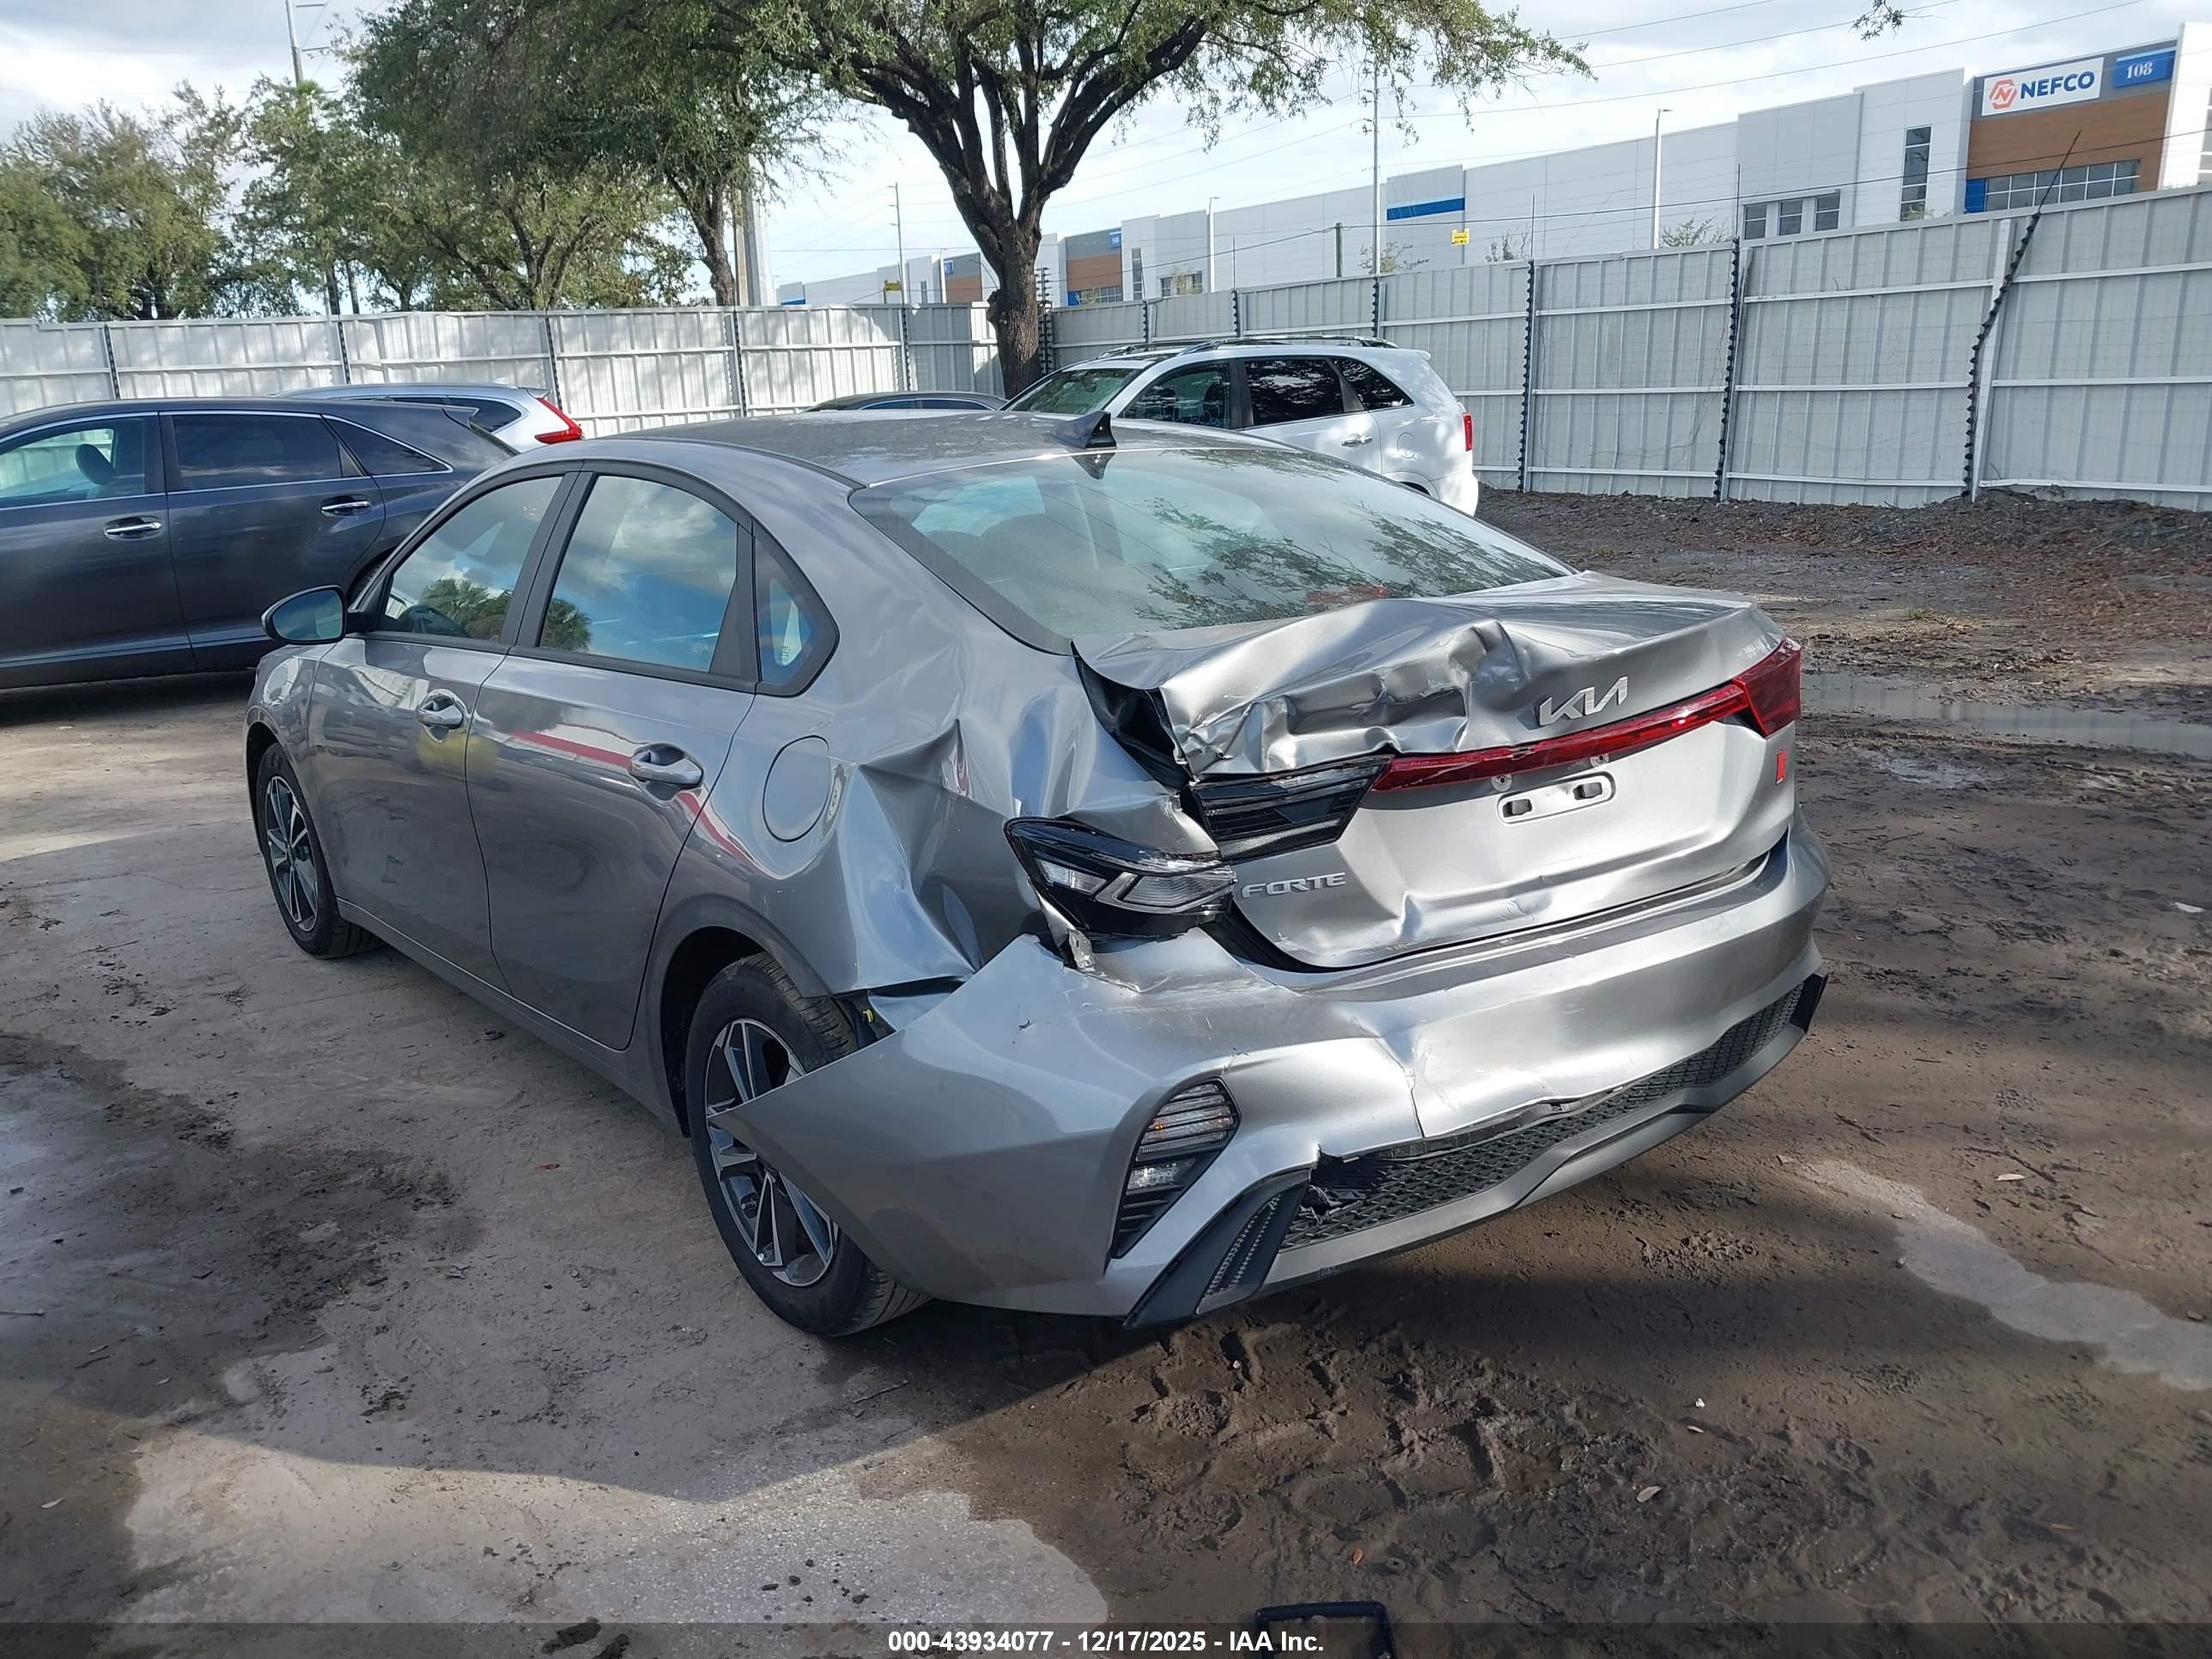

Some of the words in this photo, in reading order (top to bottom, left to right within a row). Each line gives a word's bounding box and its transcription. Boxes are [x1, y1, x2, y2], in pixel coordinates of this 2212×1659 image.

[2127, 61, 2153, 78] 108
[2020, 70, 2095, 100] NEFCO
[1540, 676, 1628, 726] KIA
[1242, 872, 1346, 897] FORTE
